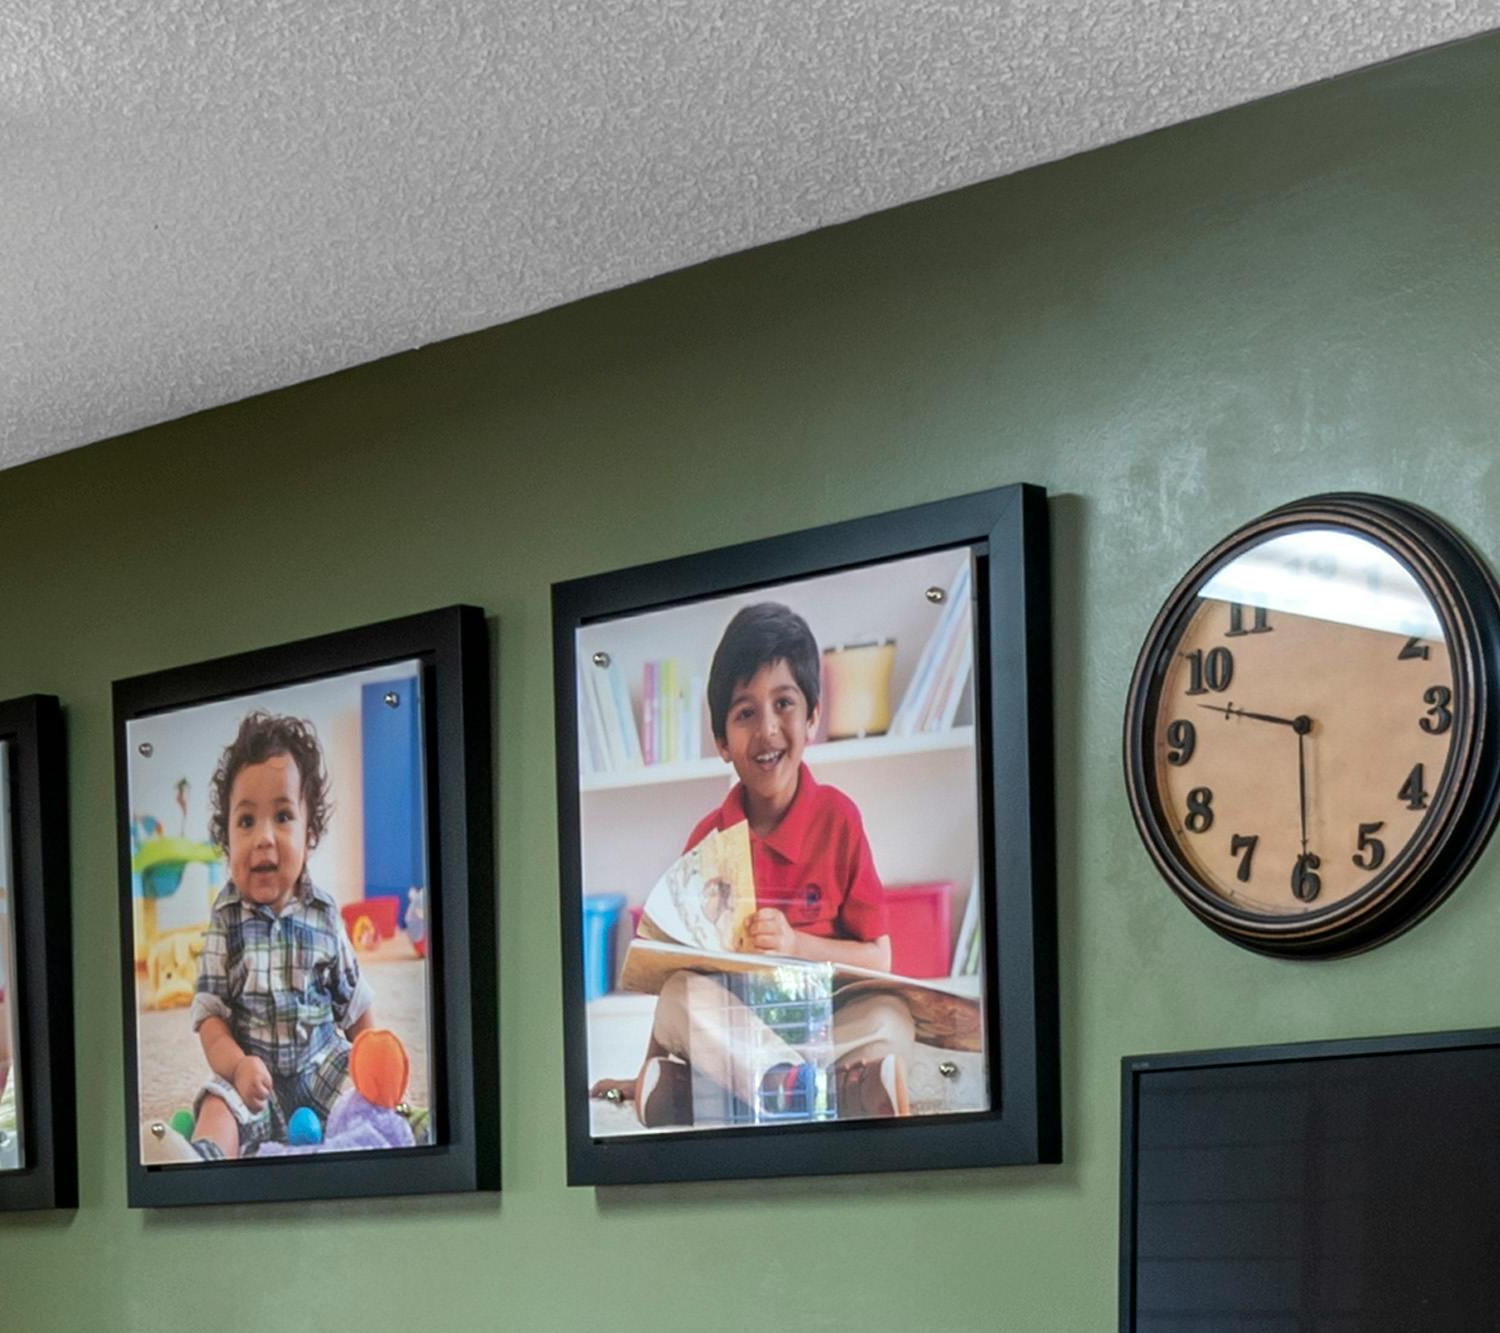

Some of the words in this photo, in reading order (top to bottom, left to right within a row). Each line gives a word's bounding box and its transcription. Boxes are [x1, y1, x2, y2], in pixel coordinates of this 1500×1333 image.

[1184, 646, 1233, 695] 10
[1418, 686, 1451, 734] 3
[1167, 720, 1196, 766] 9
[1184, 787, 1214, 833] 8
[1398, 763, 1428, 810] 4
[1230, 834, 1258, 882] 7
[1352, 821, 1386, 870] 5
[1291, 852, 1320, 901] 6
